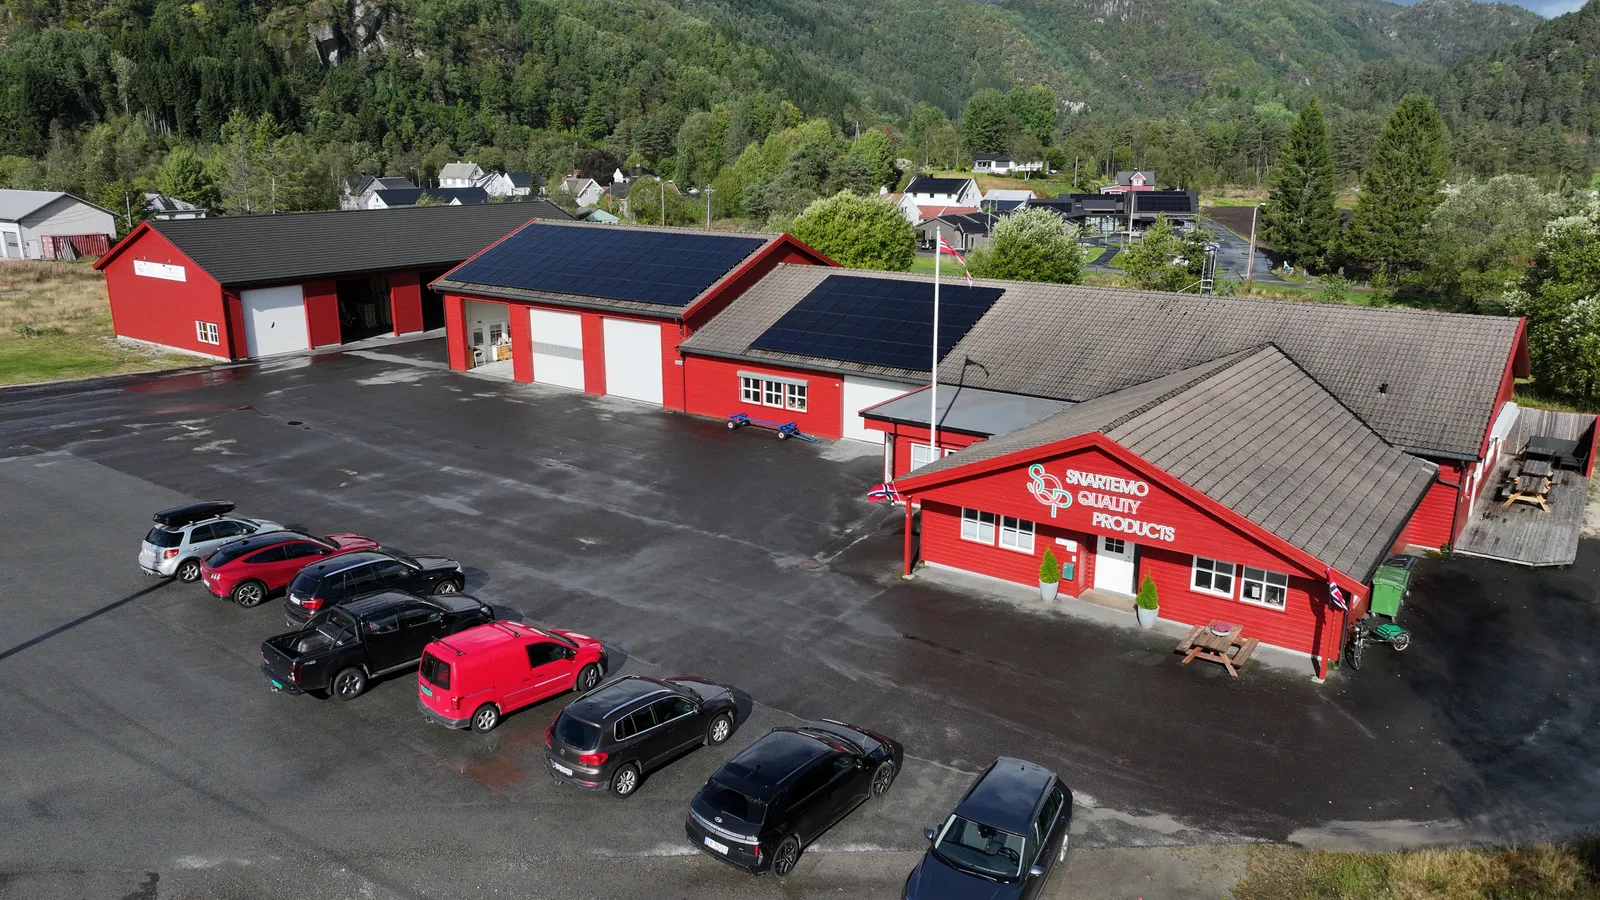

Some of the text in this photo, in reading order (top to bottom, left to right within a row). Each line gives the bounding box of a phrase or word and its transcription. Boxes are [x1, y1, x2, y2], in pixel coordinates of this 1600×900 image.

[1066, 469, 1149, 497] SNARTEMO
[1078, 491, 1141, 514] QUALITY
[1092, 512, 1175, 542] PRODUCTS
